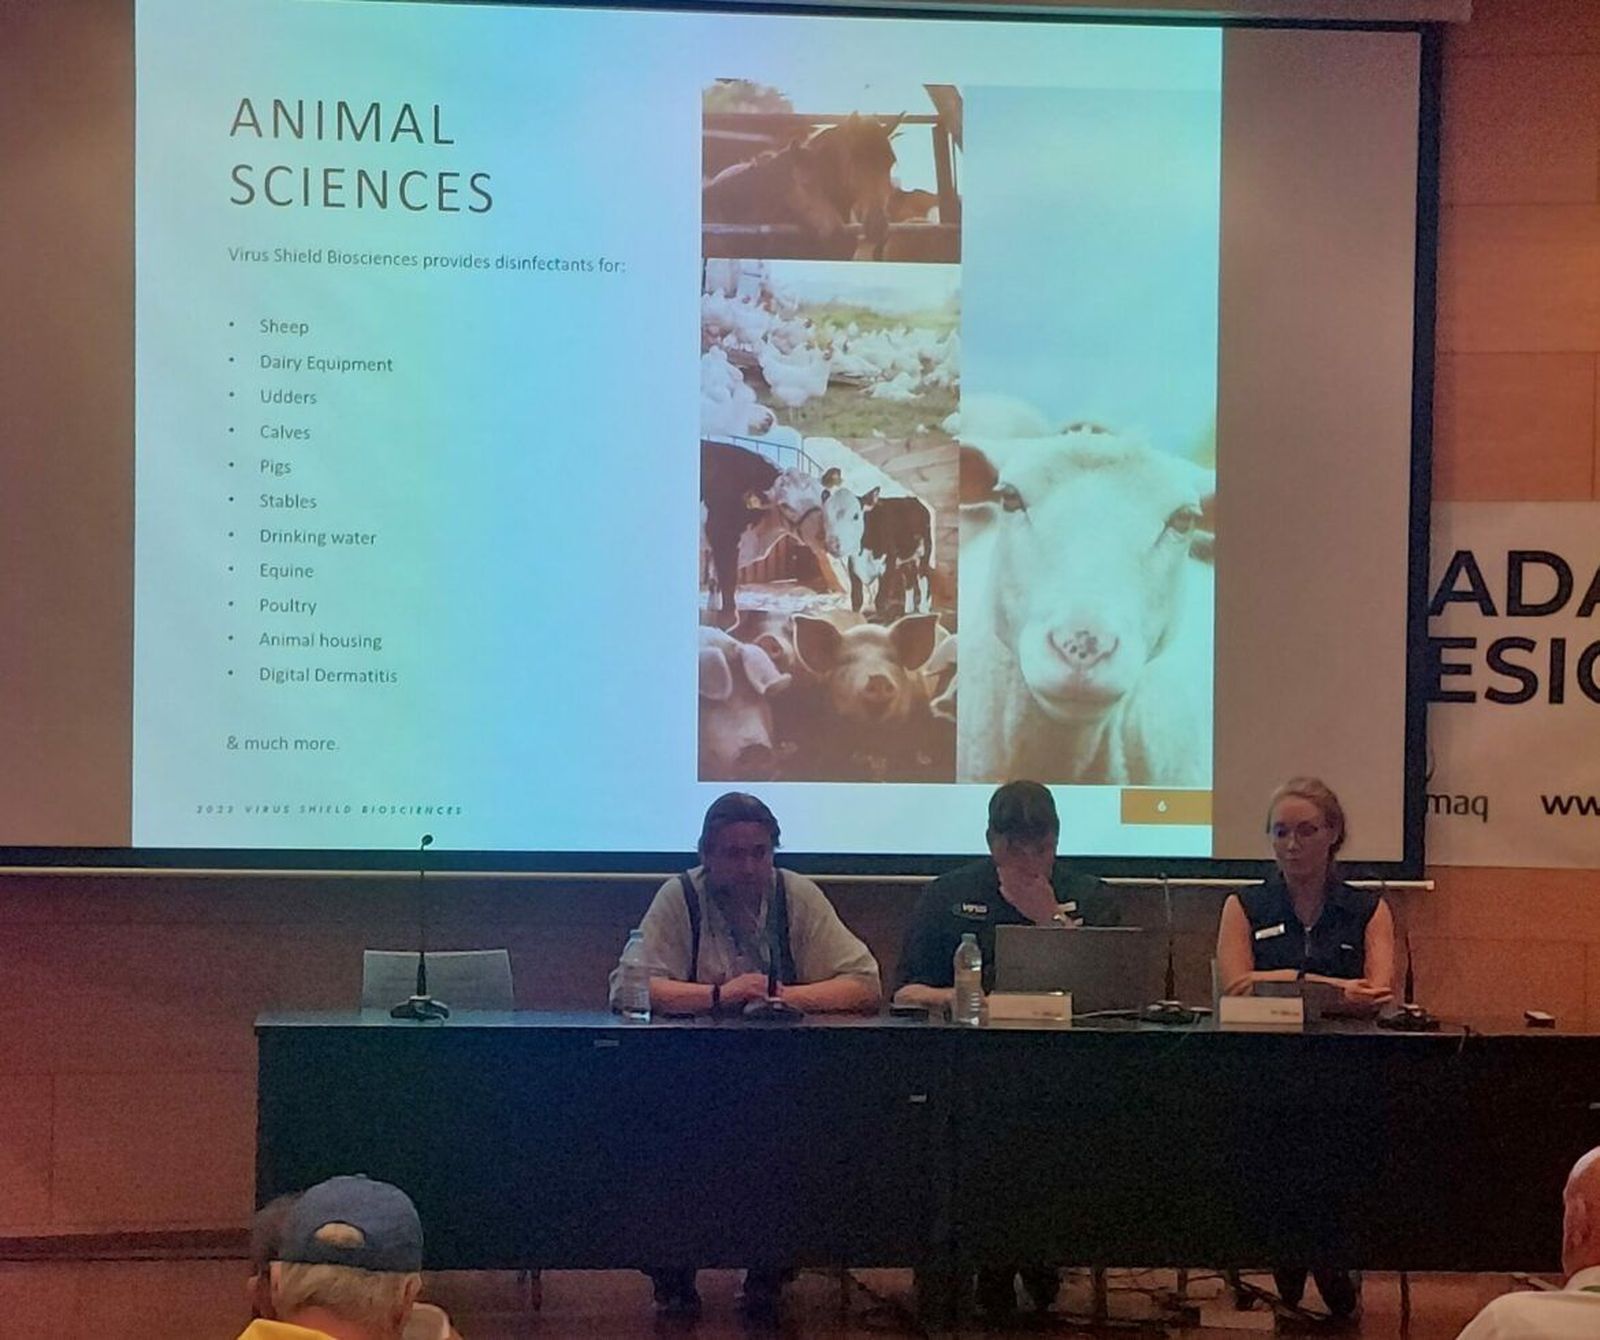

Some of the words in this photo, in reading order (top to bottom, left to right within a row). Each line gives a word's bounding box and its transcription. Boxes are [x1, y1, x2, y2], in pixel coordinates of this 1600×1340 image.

[229, 97, 455, 145] ANIMAL
[229, 164, 494, 213] SCIENCES
[228, 247, 269, 262] Virus
[274, 249, 321, 264] Shield
[327, 250, 418, 266] Biosciences
[423, 255, 490, 270] provides
[495, 255, 593, 272] disinfectants
[599, 257, 626, 272] for:
[259, 319, 309, 336] Sheep
[260, 354, 301, 372] Dairy
[307, 356, 393, 374] Equipment
[260, 388, 317, 405] Udders
[260, 423, 311, 440] Calves
[260, 458, 291, 475] Pigs
[260, 493, 317, 509] Stables
[260, 528, 327, 547] Drinking
[331, 532, 377, 546] water
[260, 563, 314, 580] Equine
[260, 597, 317, 616] Poultry
[259, 632, 315, 648] Animal
[319, 633, 382, 651] housing
[259, 667, 310, 684] Digital
[315, 668, 398, 684] Dermatitis
[227, 736, 239, 751] &
[244, 736, 288, 751] much
[294, 739, 339, 752] more.
[244, 804, 291, 815] VIRUS
[300, 805, 352, 815] SHIELD
[361, 805, 463, 816] BIOSCIENCES
[1425, 794, 1489, 824] maq
